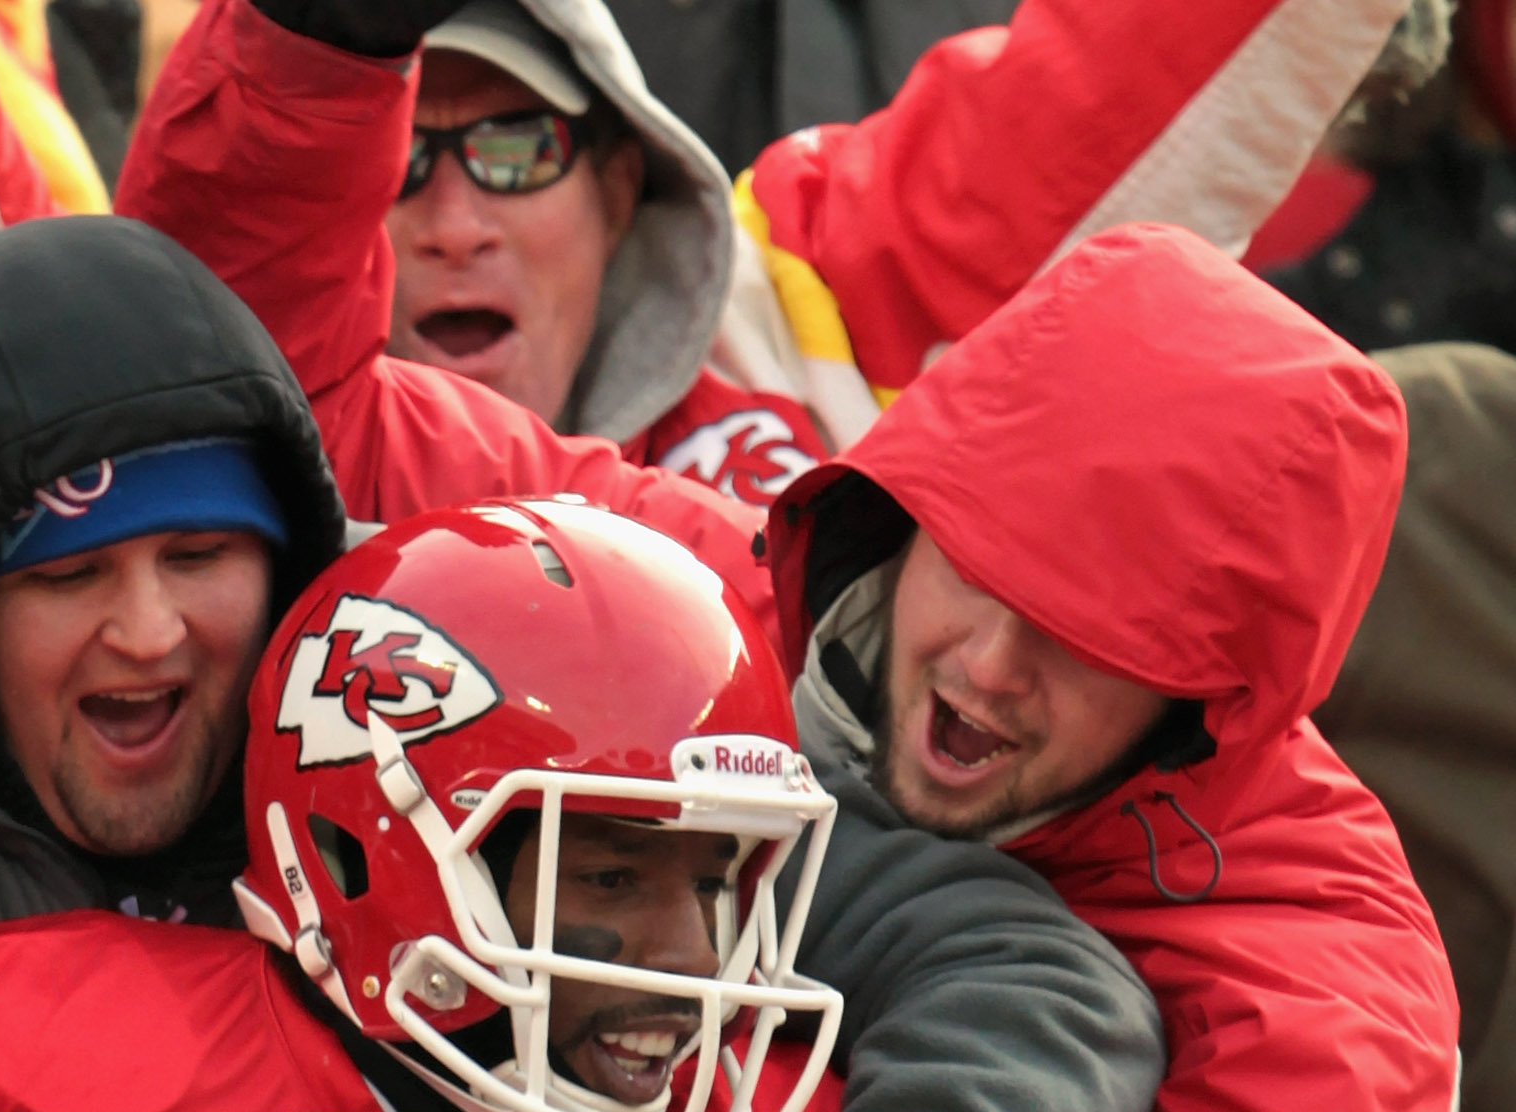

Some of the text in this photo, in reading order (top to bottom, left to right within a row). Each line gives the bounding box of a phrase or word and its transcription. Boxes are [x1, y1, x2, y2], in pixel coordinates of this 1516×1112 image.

[312, 629, 458, 732] KC
[714, 744, 783, 777] Riddell
[285, 866, 303, 896] 82
